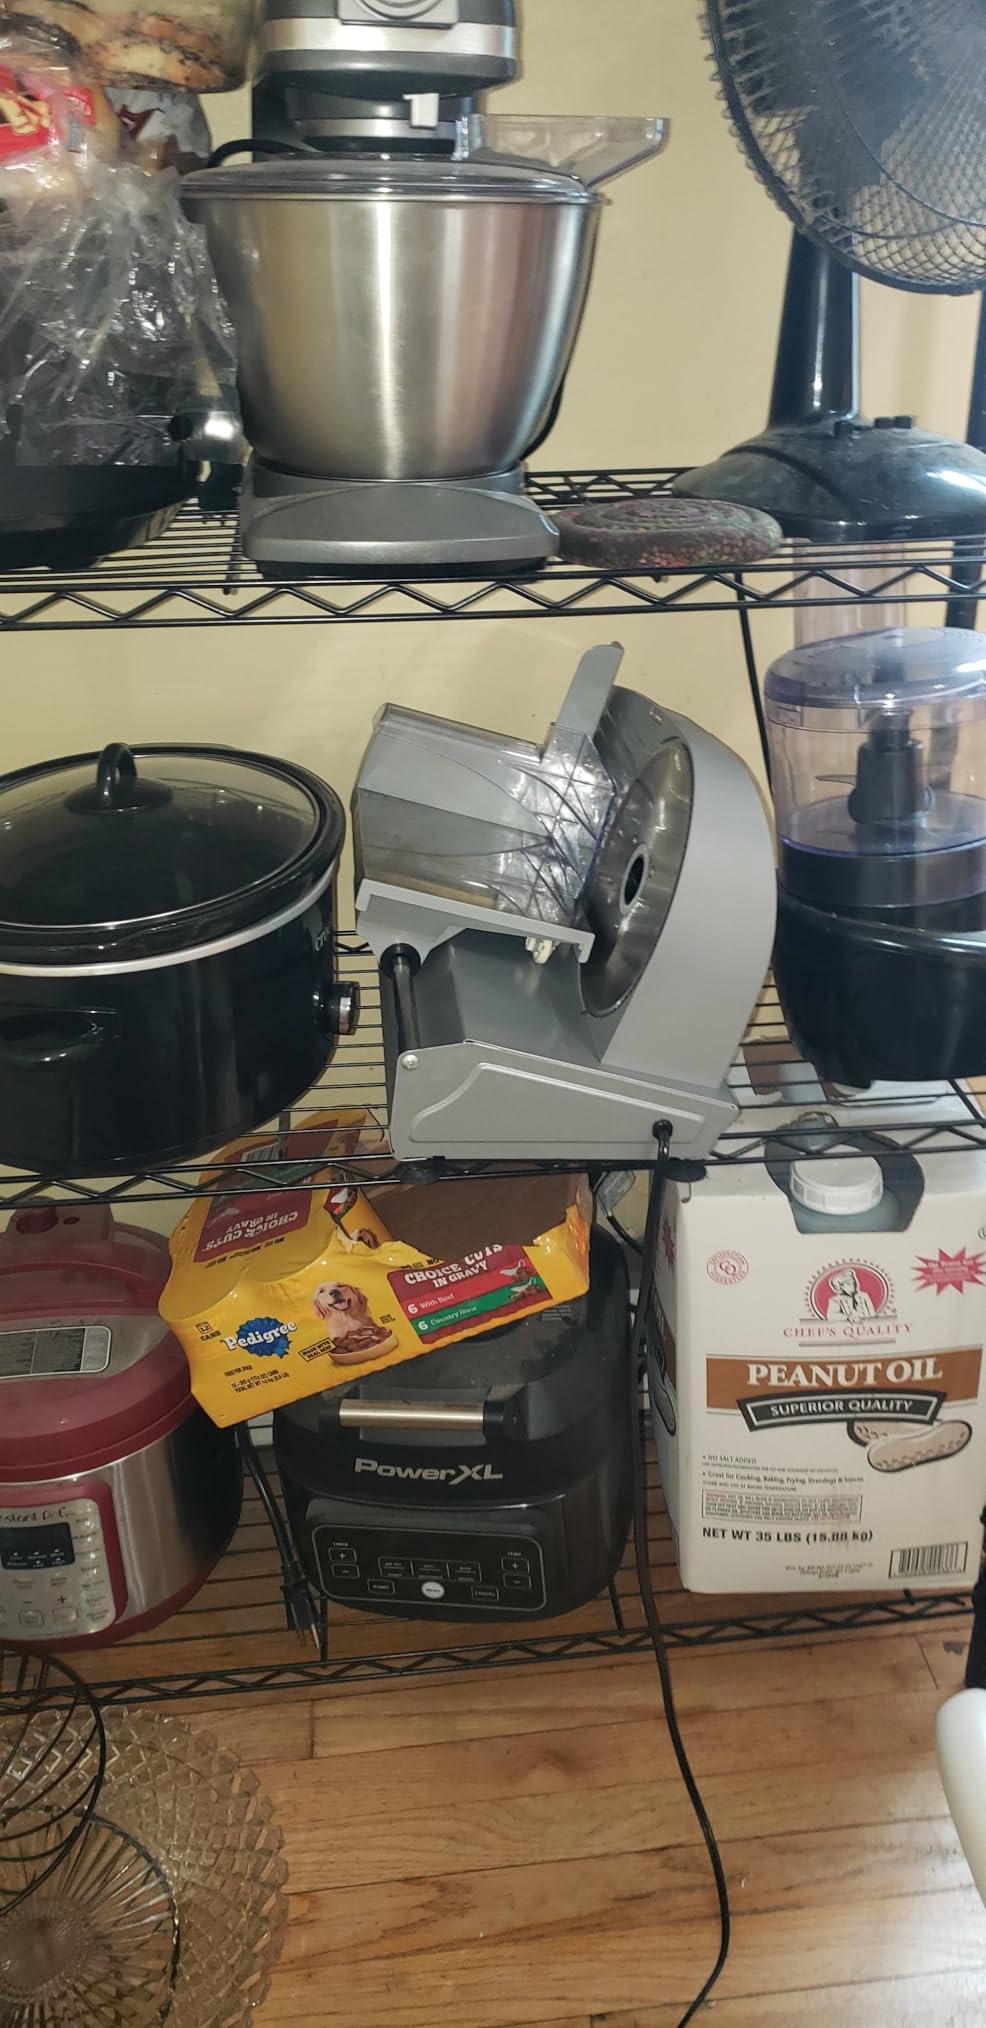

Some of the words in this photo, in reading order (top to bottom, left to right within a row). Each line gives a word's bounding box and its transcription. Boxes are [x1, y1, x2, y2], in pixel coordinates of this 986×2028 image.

[244, 1211, 299, 1238] CHOICE
[404, 1262, 462, 1285] CHOICE
[432, 1276, 448, 1289] IN
[449, 1260, 489, 1283] GRAVY
[407, 1303, 419, 1315] 6
[419, 1297, 438, 1310] With
[417, 1320, 429, 1331] 6
[430, 1309, 459, 1327] Country
[783, 1326, 837, 1339] CHEF'S
[843, 1321, 913, 1339] QUALITY
[200, 1330, 222, 1341] CANS
[223, 1321, 298, 1351] Pedigree
[746, 1361, 882, 1387] PEANUT
[885, 1357, 943, 1384] OIL
[770, 1401, 844, 1417] SUPERIOR
[848, 1400, 913, 1413] QUALITY
[354, 1457, 504, 1486] PowerXL
[0, 1512, 38, 1523] stant
[702, 1527, 727, 1539] NET
[731, 1529, 751, 1542] WT
[755, 1531, 772, 1542] 35
[776, 1531, 801, 1543] LBS
[851, 1529, 874, 1543] kg)
